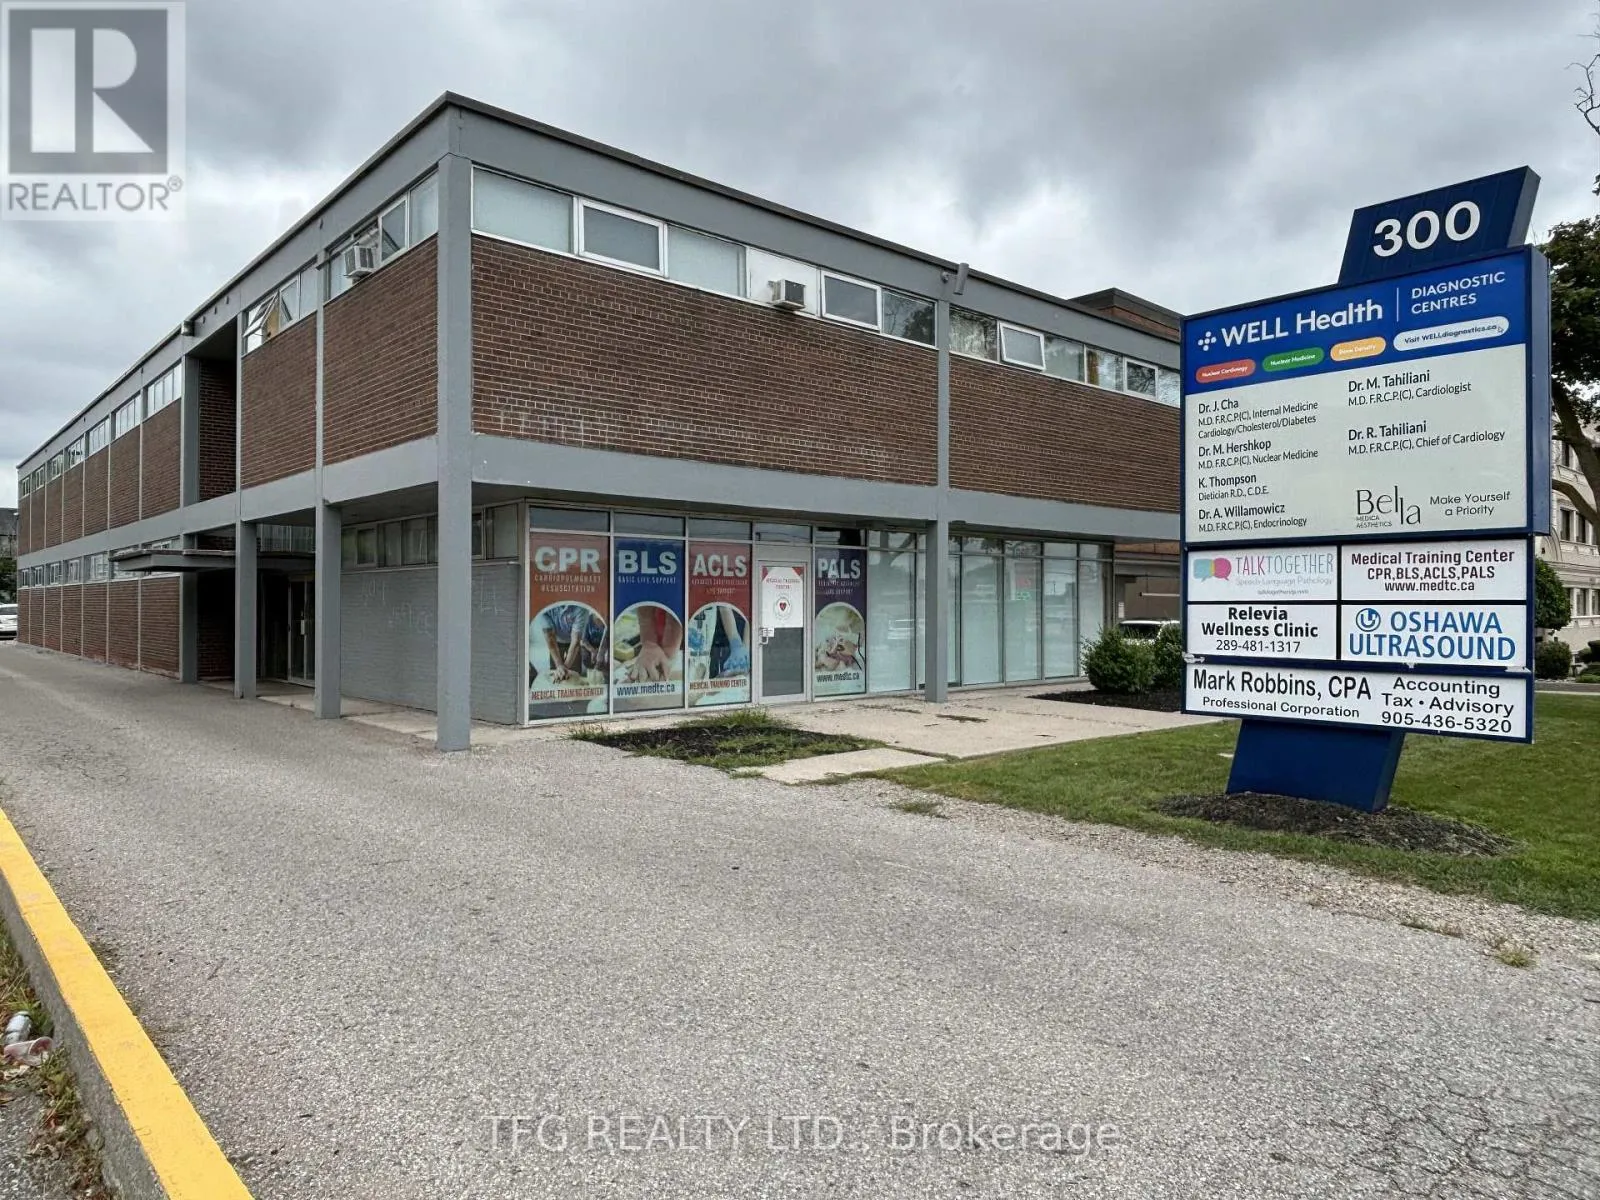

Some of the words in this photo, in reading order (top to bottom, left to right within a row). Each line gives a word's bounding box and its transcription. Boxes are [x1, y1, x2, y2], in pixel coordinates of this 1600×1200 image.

[1373, 201, 1480, 257] 300
[1411, 271, 1506, 299] DIAGNOSTIC
[1411, 293, 1477, 315] CENTRES
[1221, 317, 1289, 347] WELL
[1296, 299, 1383, 334] Health
[1348, 380, 1364, 393] Dr.
[1366, 377, 1381, 390] M.
[1382, 369, 1430, 388] Tahiliani
[1348, 395, 1368, 407] M.D.
[1415, 381, 1472, 398] Cardiologist
[1198, 403, 1211, 414] Dr.
[1213, 401, 1220, 412] J.
[1221, 399, 1239, 410] Cha
[1198, 416, 1214, 427] M.D.
[1252, 406, 1281, 419] Internal
[1282, 401, 1318, 414] Medicine
[1198, 415, 1317, 439] Cardiology/Cholesterol/Diabetes
[1348, 429, 1364, 441] Dr.
[1366, 427, 1377, 439] R.
[1379, 420, 1427, 437] Tahiliani
[1198, 446, 1212, 457] Dr.
[1213, 444, 1225, 455] M.
[1226, 439, 1271, 454] Hershkop
[1348, 444, 1368, 456] M.D.
[1415, 435, 1440, 449] Chief
[1441, 434, 1451, 446] of
[1452, 430, 1505, 444] Cardiology
[1198, 460, 1214, 470] M.D.
[1252, 453, 1281, 464] Nuclear
[1282, 449, 1318, 461] Medicine
[1198, 478, 1208, 489] K.
[1209, 474, 1257, 487] Thompson
[1198, 490, 1229, 501] Dietician
[1247, 485, 1269, 496] C.D.E.
[1430, 495, 1461, 505] Make
[1465, 491, 1511, 503] Yourself
[1199, 509, 1212, 520] Dr.
[1213, 508, 1223, 519] A.
[1224, 503, 1285, 518] Willamowicz
[1357, 485, 1421, 525] Bella
[1445, 509, 1453, 517] a
[1456, 505, 1495, 516] Priority
[1199, 523, 1215, 533] M.D.
[1254, 517, 1307, 529] Endocrinology
[535, 546, 601, 573] CPR
[618, 550, 677, 575] BLS
[693, 554, 747, 577] ACLS
[1236, 553, 1334, 576] TALKTOGETHER
[1352, 552, 1401, 565] Medical
[1405, 550, 1461, 566] Training
[1466, 549, 1515, 563] Center
[818, 559, 861, 579] PALS
[1385, 580, 1475, 592] www.medtc.ca
[1228, 606, 1288, 620] Relevia
[1391, 611, 1502, 634] OSHAWA
[1202, 622, 1269, 637] Wellness
[1274, 622, 1318, 638] Clinic
[1216, 640, 1301, 653] 289-481-1317
[1349, 633, 1516, 661] ULTRASOUND
[531, 690, 556, 700] MEDICAL
[617, 682, 676, 696] www.medtc.ca
[689, 681, 709, 690] MEDICAL
[731, 678, 747, 688] CENTER
[1194, 669, 1236, 692] Mark
[1241, 671, 1322, 701] Robbins,
[1328, 675, 1372, 700] CPA
[1393, 677, 1500, 699] Accounting
[1203, 696, 1277, 712] Professional
[1281, 702, 1360, 718] Corporation
[1381, 693, 1413, 708] Tax
[1429, 696, 1514, 718] Advisory
[1381, 711, 1512, 733] 905-436-5320
